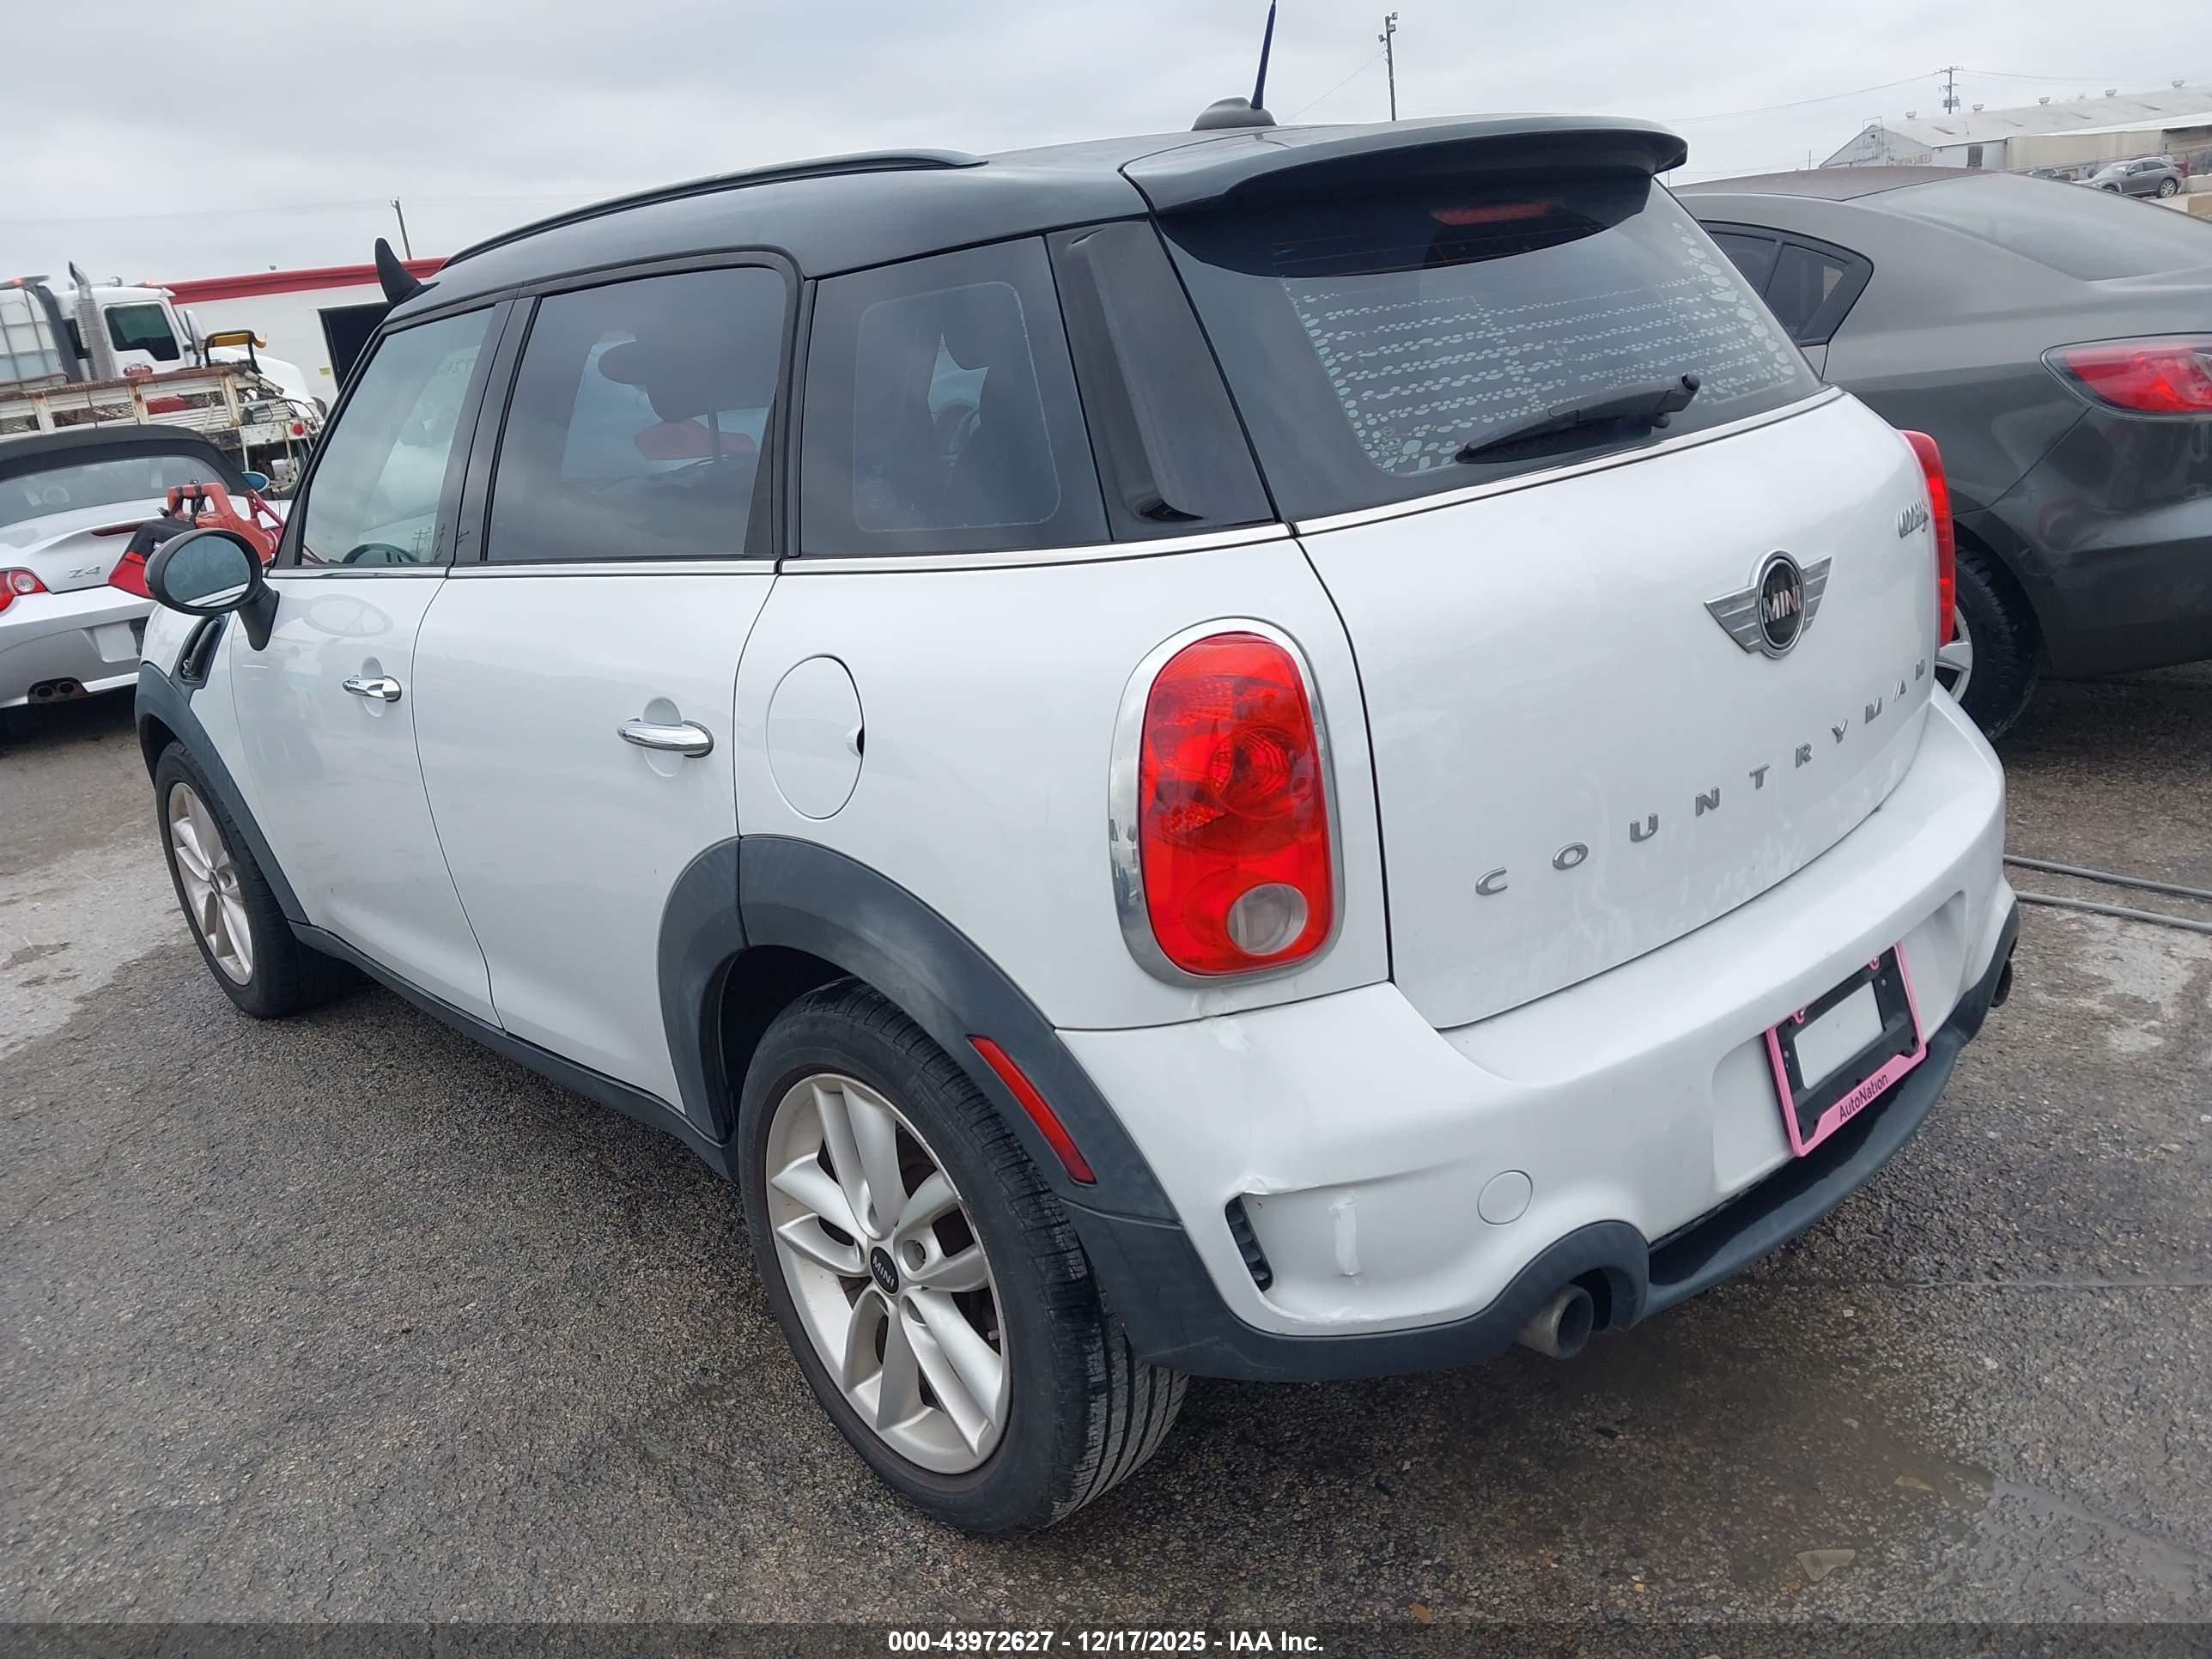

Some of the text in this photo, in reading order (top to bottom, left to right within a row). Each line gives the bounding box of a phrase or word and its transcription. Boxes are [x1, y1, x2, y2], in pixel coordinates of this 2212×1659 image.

[69, 565, 100, 578] Z4
[1763, 585, 1801, 623] MINI
[1475, 659, 1926, 896] COUNTRYMAN
[1838, 1073, 1888, 1122] AutoNation
[872, 1255, 895, 1287] MINI
